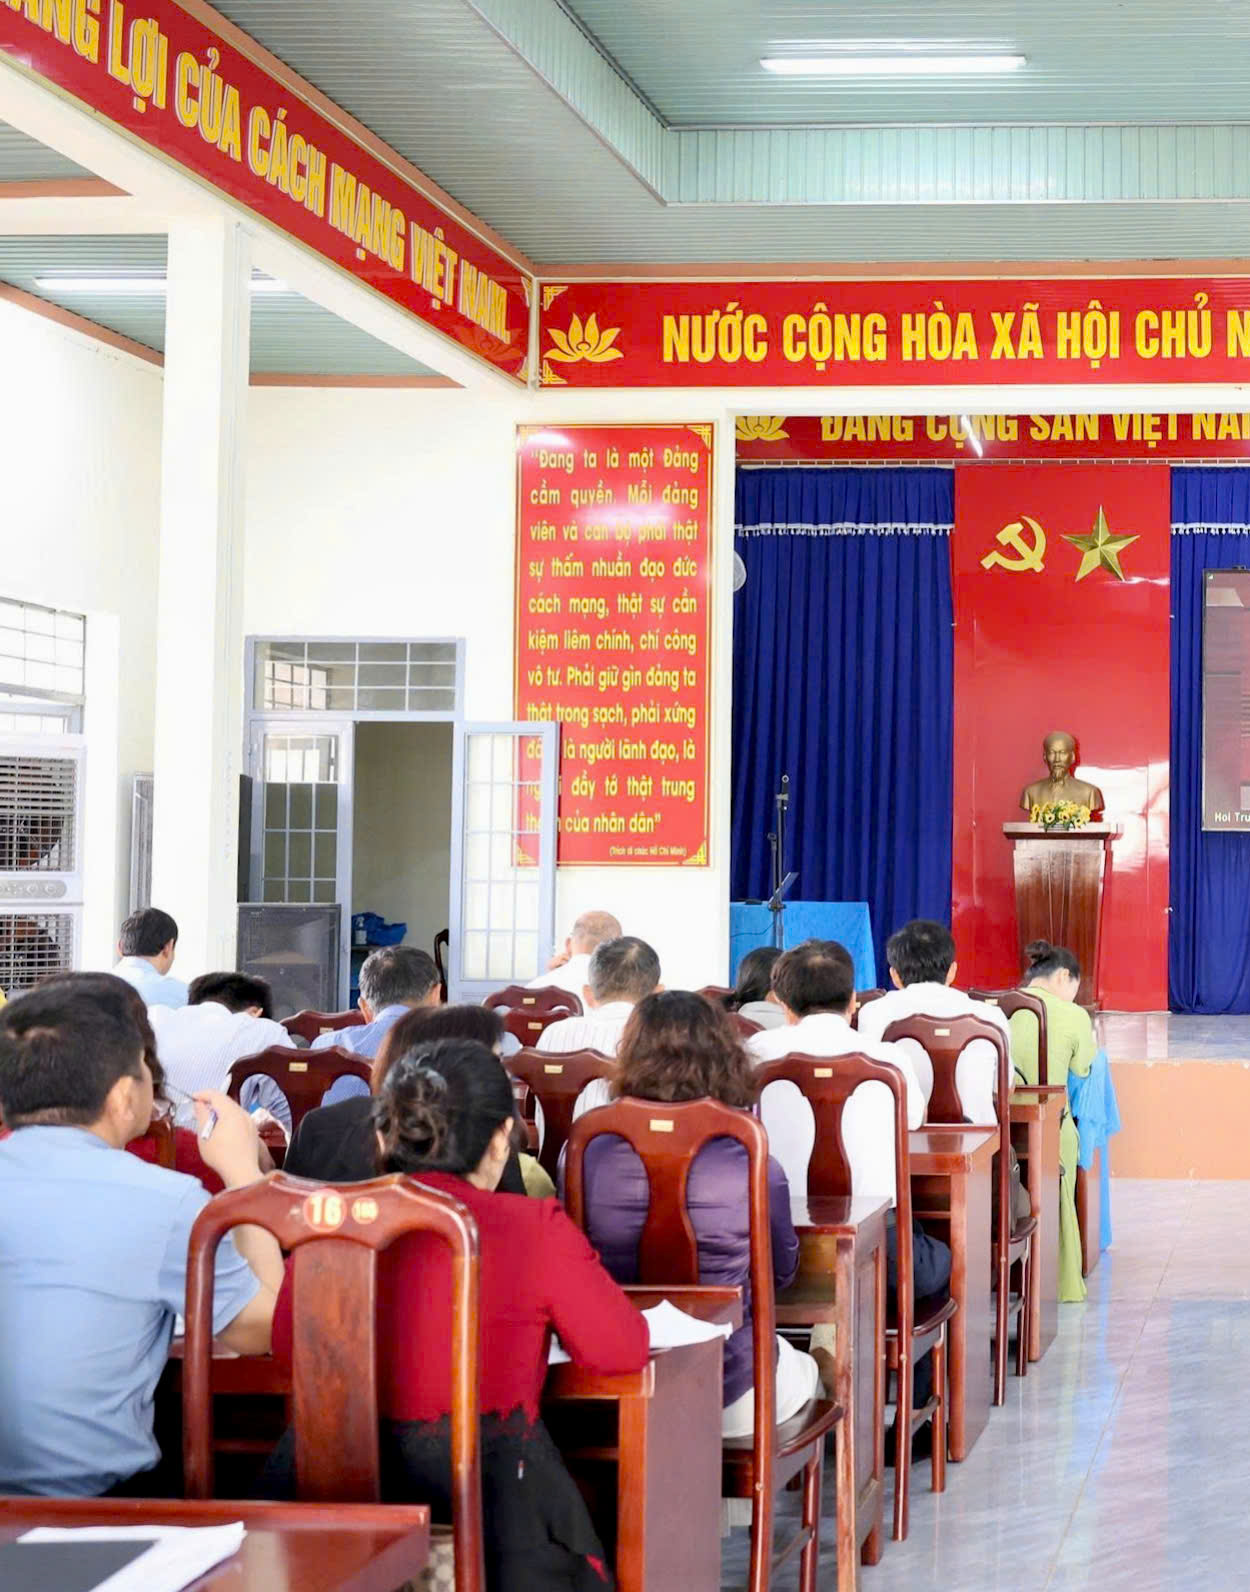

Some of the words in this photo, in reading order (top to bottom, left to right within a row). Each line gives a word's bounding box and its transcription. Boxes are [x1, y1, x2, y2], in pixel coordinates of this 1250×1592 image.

[108, 0, 168, 113] LỢI
[175, 47, 242, 162] CỦA
[248, 106, 327, 218] CÁCH
[328, 163, 405, 273] MẠNG
[410, 220, 458, 311] VIỆT
[663, 301, 769, 363] NƯỚC
[782, 302, 888, 371] CỘNG
[901, 301, 979, 361] HÒA
[990, 302, 1045, 361] XÃ
[1057, 299, 1121, 369] HỘI
[1135, 292, 1214, 360] CHỦ
